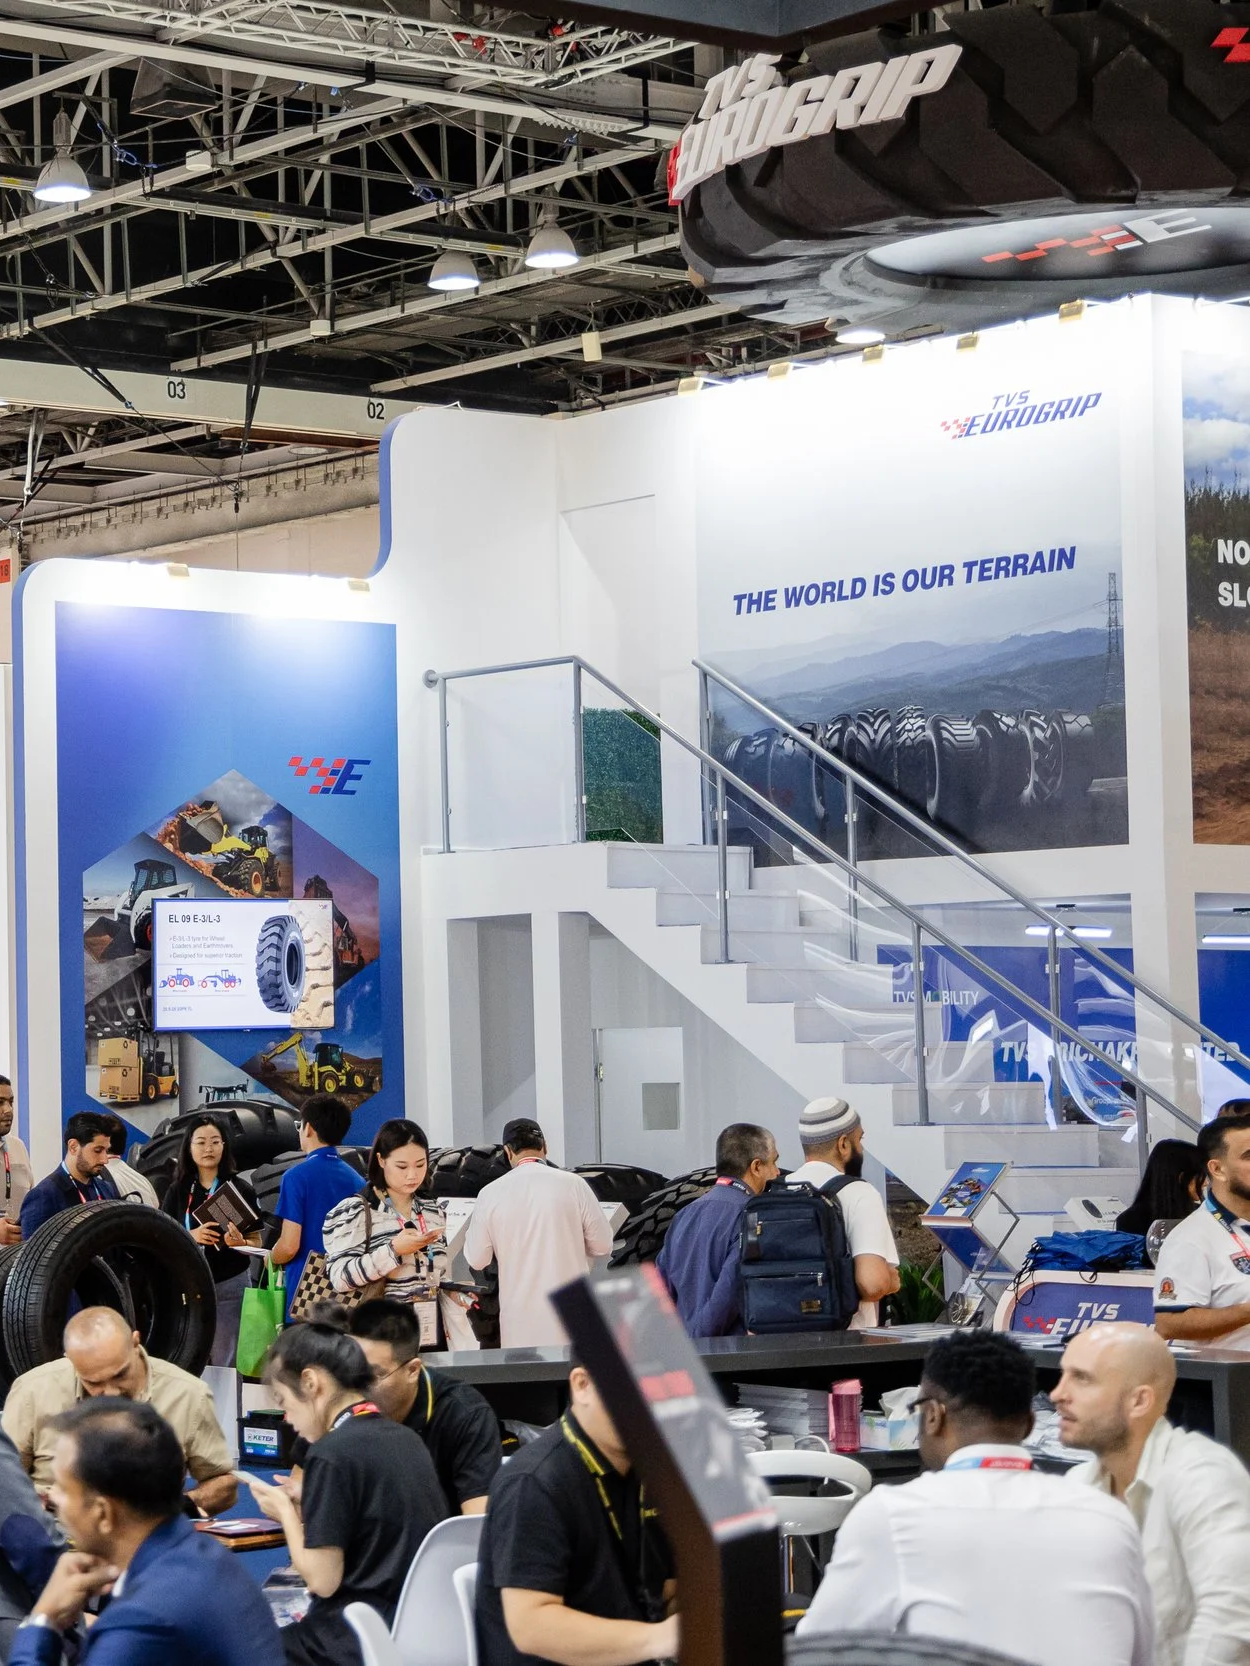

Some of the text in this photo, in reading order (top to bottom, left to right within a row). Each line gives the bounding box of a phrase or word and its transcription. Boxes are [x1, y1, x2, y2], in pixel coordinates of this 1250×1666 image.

[698, 53, 782, 119] TVS
[672, 44, 962, 200] EUROGRIP
[167, 381, 186, 400] 03
[992, 390, 1030, 410] TVS
[367, 403, 385, 420] 02
[964, 392, 1102, 437] EUROGRIP
[733, 546, 1077, 616] THE WORLD IS OUR TERRAIN
[1218, 581, 1250, 608] SL
[168, 914, 221, 923] EL 09 E-3/L-3
[1077, 1302, 1120, 1320] TVS
[253, 1434, 274, 1442] KETER
